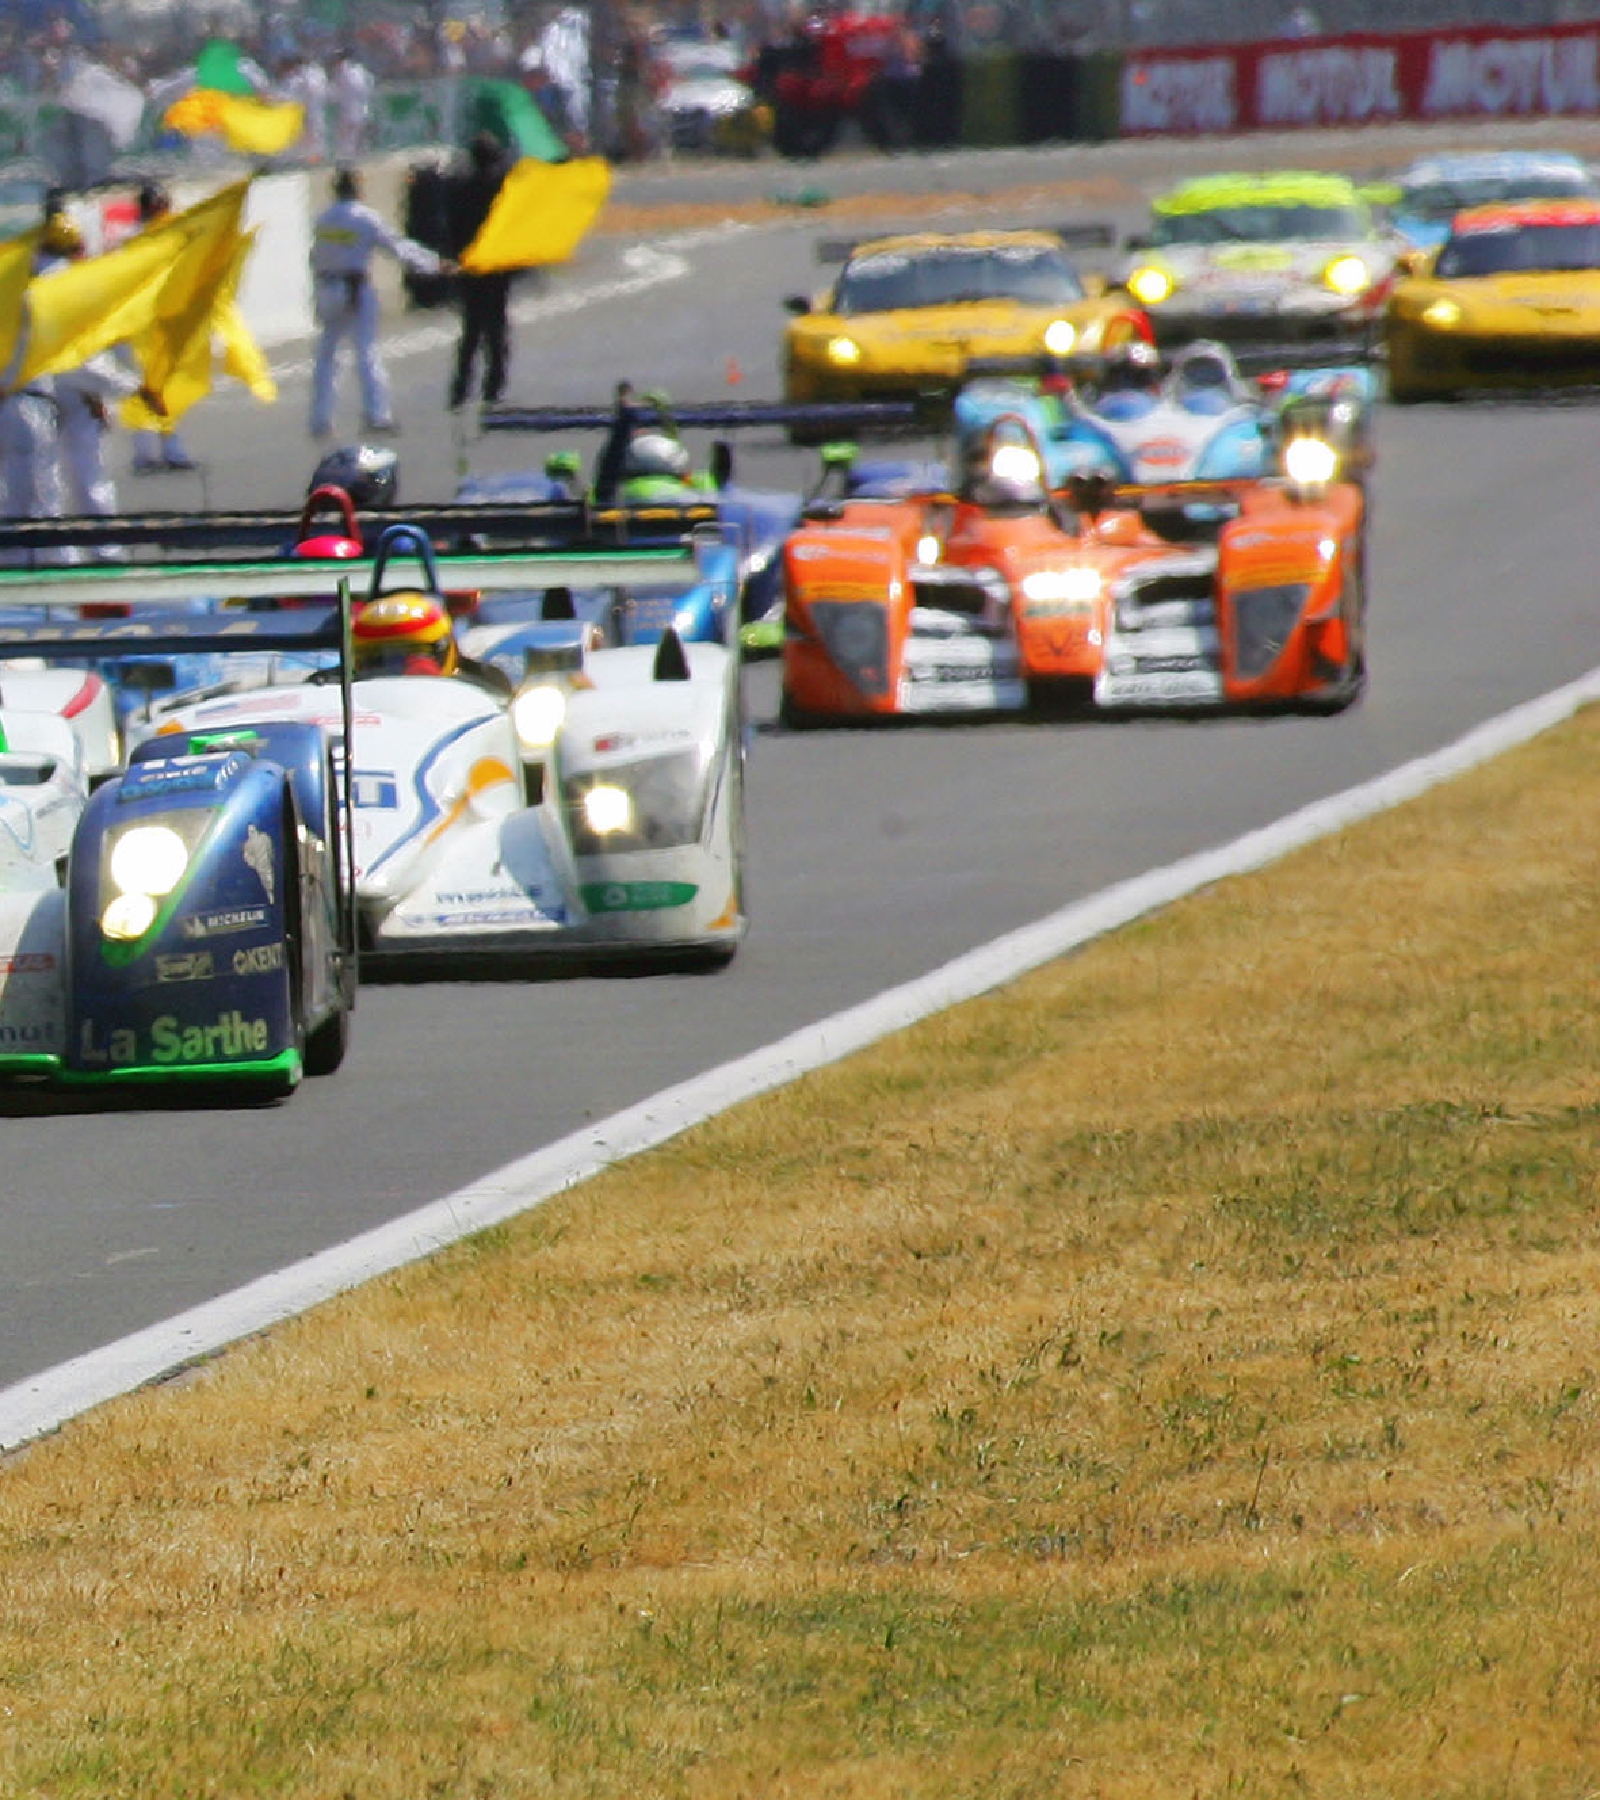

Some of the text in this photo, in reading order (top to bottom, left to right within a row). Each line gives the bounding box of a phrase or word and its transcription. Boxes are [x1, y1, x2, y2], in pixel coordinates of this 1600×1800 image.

[206, 909, 264, 929] MICHELIN
[80, 1009, 269, 1063] La Sarthe
